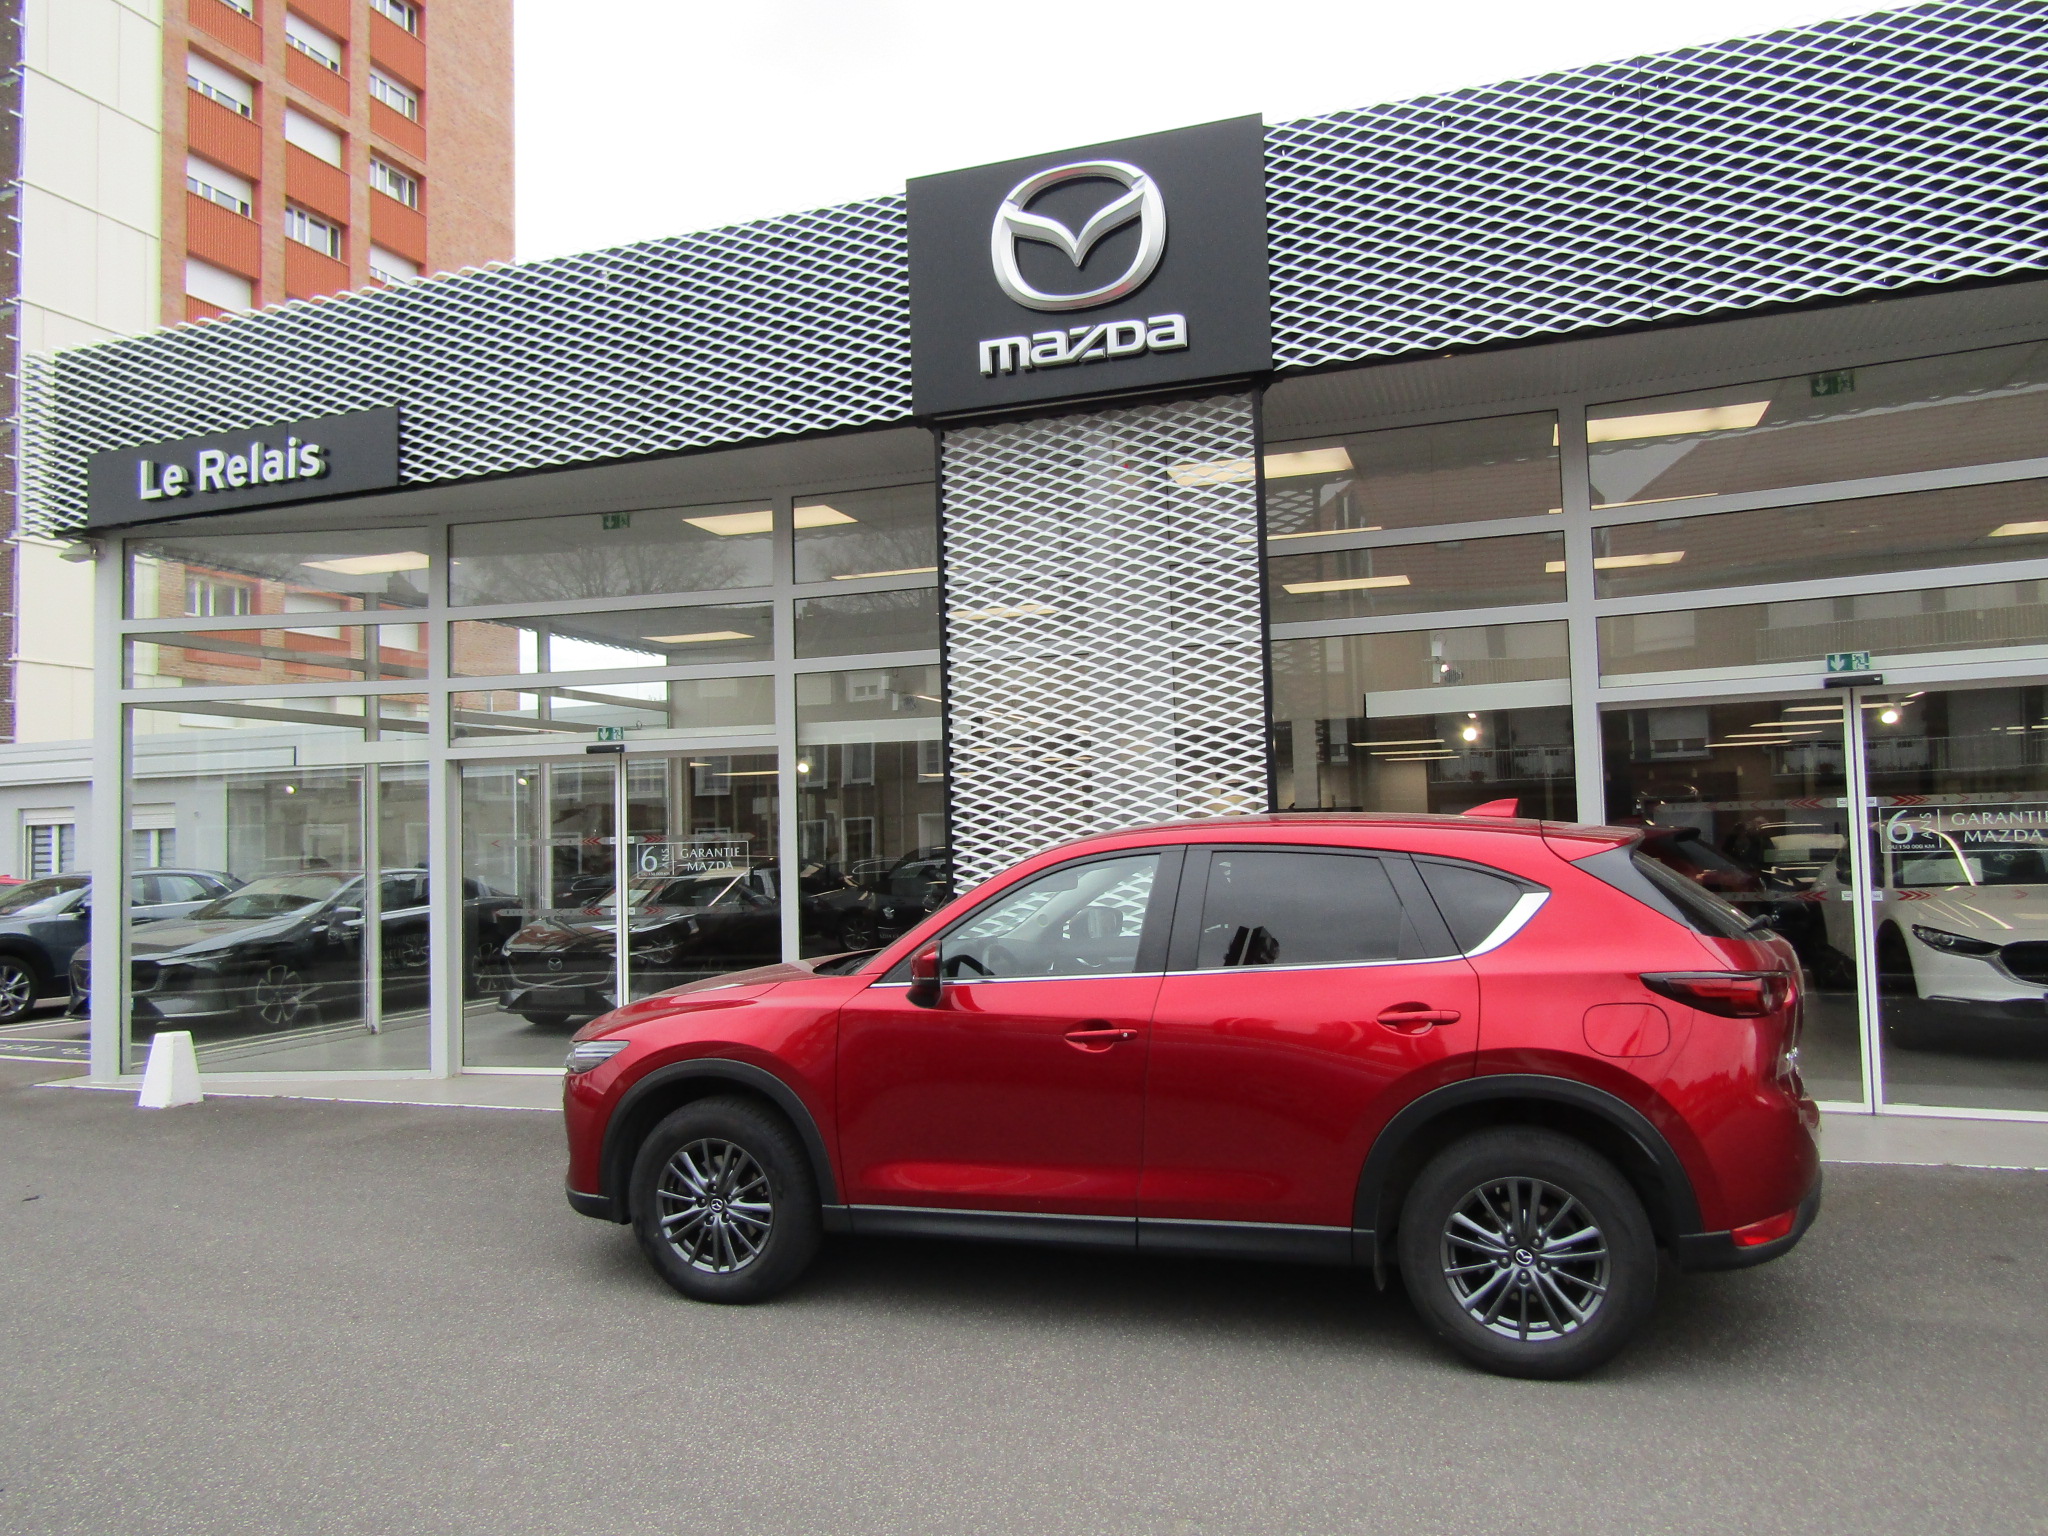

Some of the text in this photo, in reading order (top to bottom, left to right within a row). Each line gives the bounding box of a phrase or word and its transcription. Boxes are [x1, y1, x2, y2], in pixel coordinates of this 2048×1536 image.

[139, 436, 326, 500] Le Relais
[1886, 809, 1934, 844] 6 ANS
[1964, 829, 2044, 843] MAZDA
[641, 846, 670, 872] 6 ANS
[680, 847, 740, 858] GARANTIE
[687, 861, 734, 871] MAZDA
